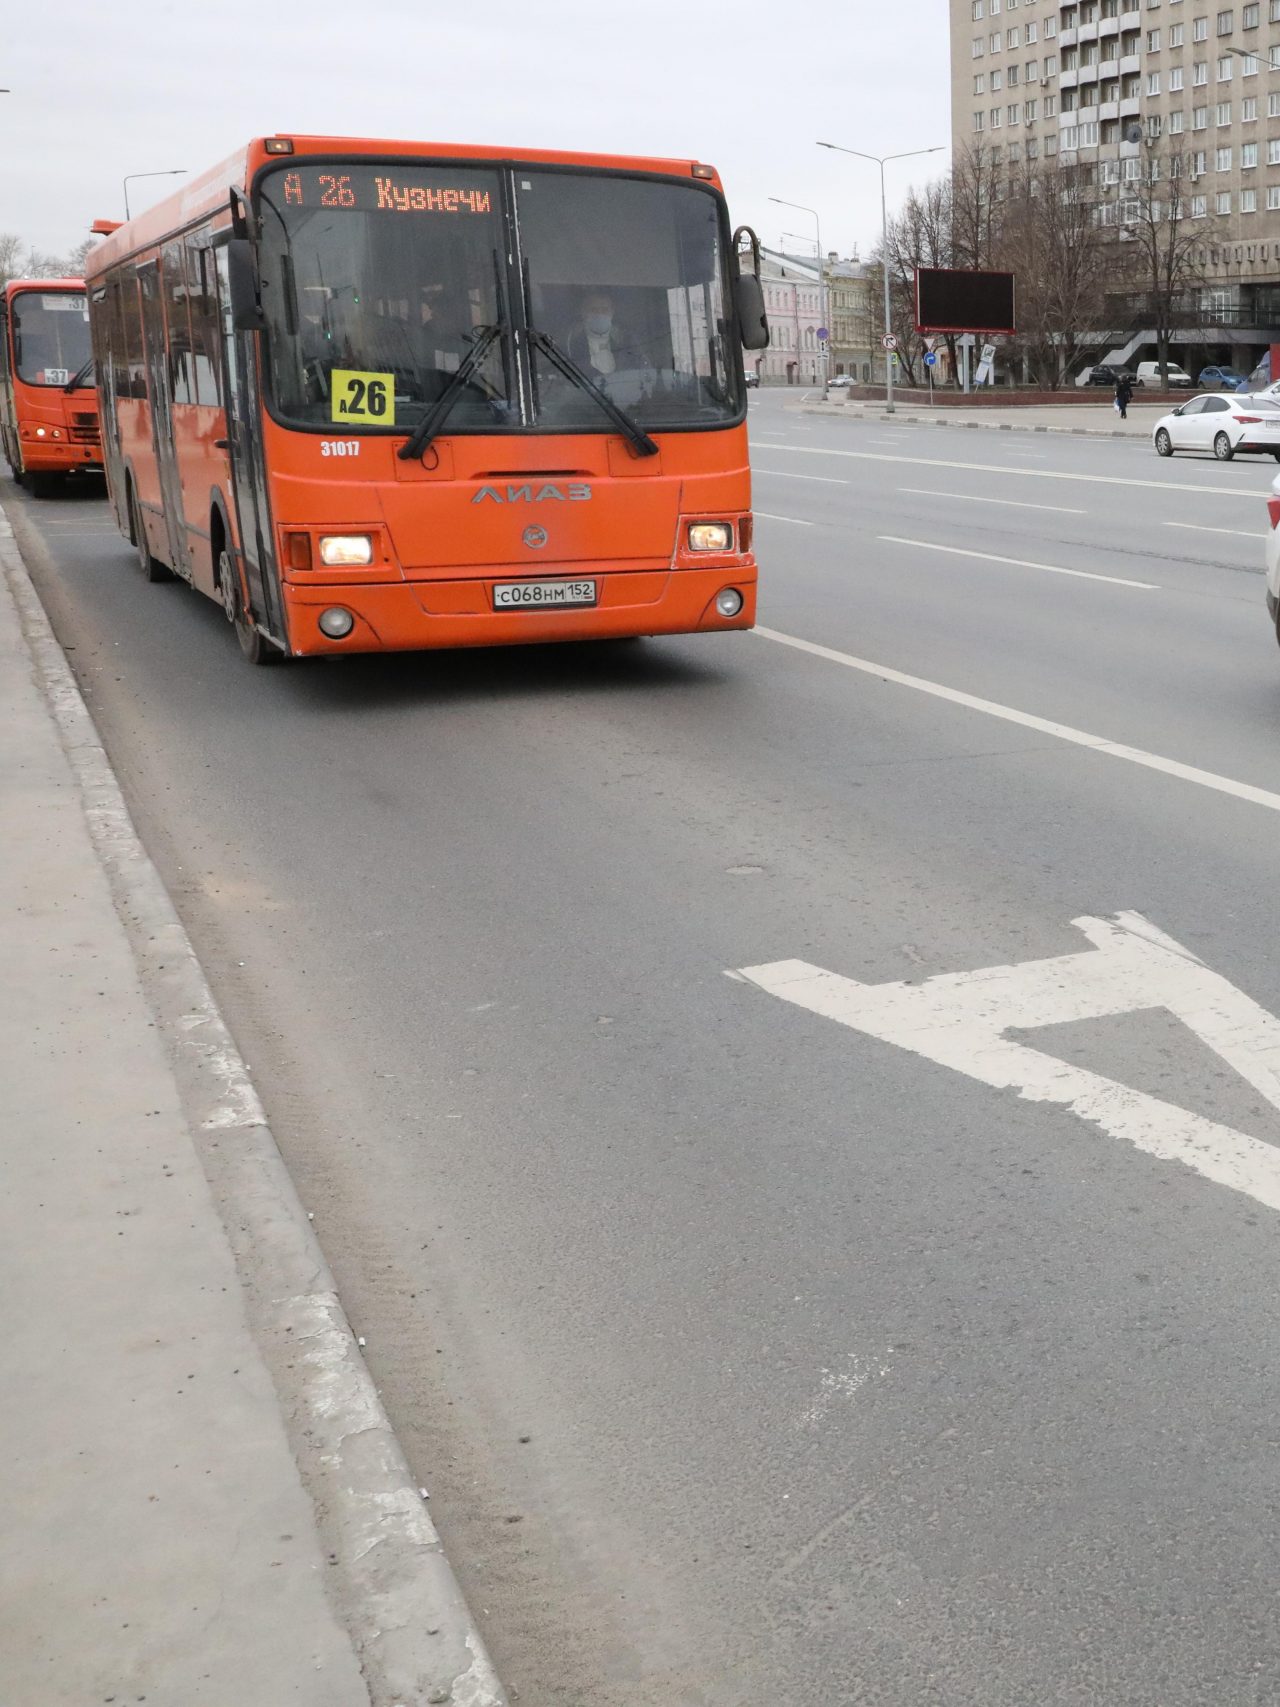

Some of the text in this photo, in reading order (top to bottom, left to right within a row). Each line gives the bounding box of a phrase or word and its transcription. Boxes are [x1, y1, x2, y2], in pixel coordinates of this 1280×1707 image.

[283, 173, 490, 212] А 26 Кузнечи
[320, 441, 360, 456] 31017
[471, 483, 593, 503] ЛИАЗ
[567, 583, 590, 596] 152
